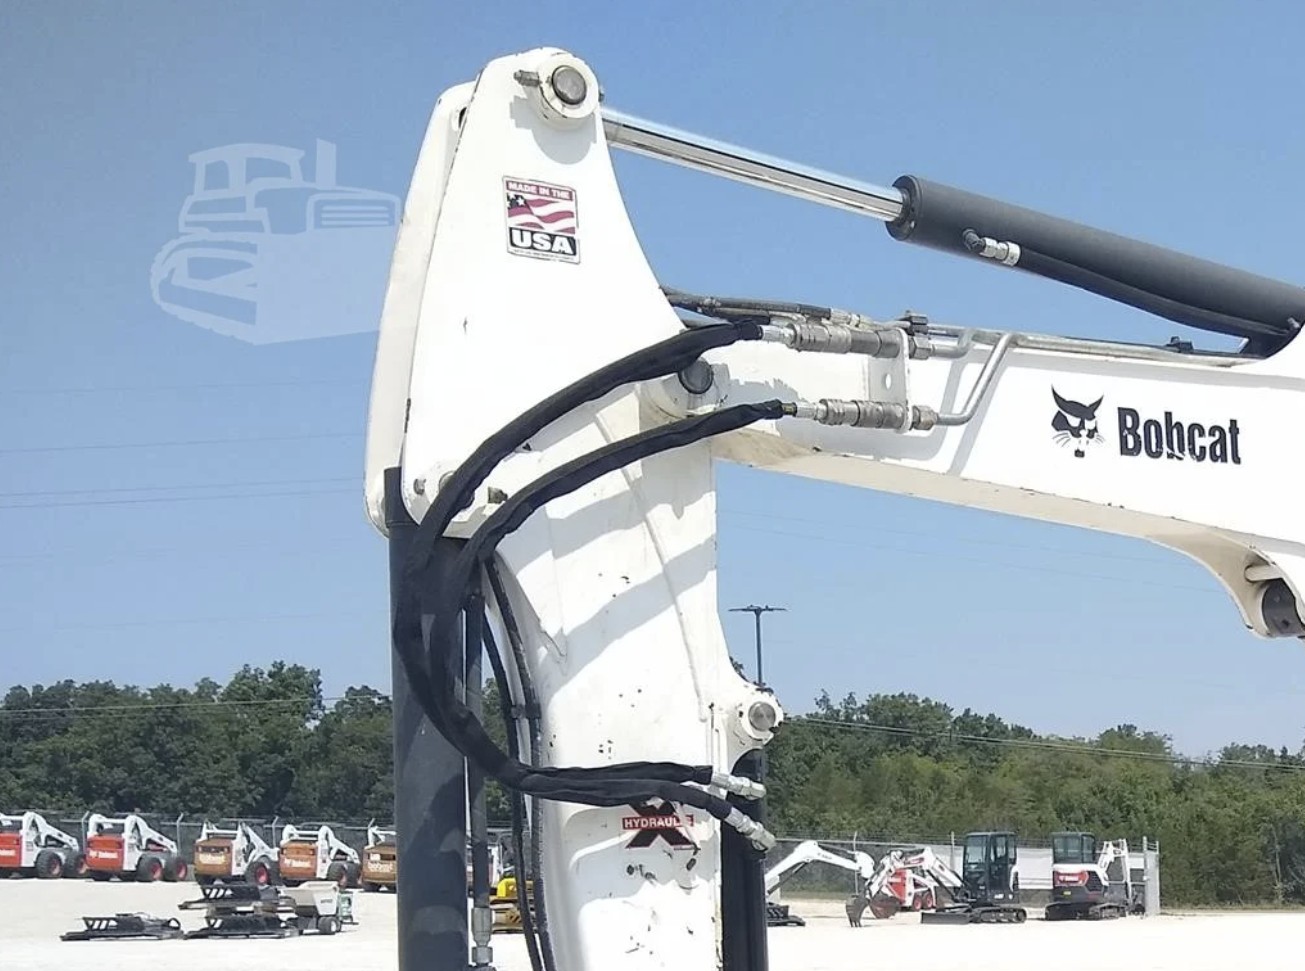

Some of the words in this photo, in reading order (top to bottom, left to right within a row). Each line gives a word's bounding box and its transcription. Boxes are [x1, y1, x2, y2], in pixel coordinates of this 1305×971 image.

[508, 181, 537, 194] MADE
[539, 185, 550, 196] IN
[552, 188, 570, 200] THE
[511, 228, 574, 255] USA
[1117, 406, 1241, 465] Bobcat
[624, 814, 693, 828] HYDRAUL
